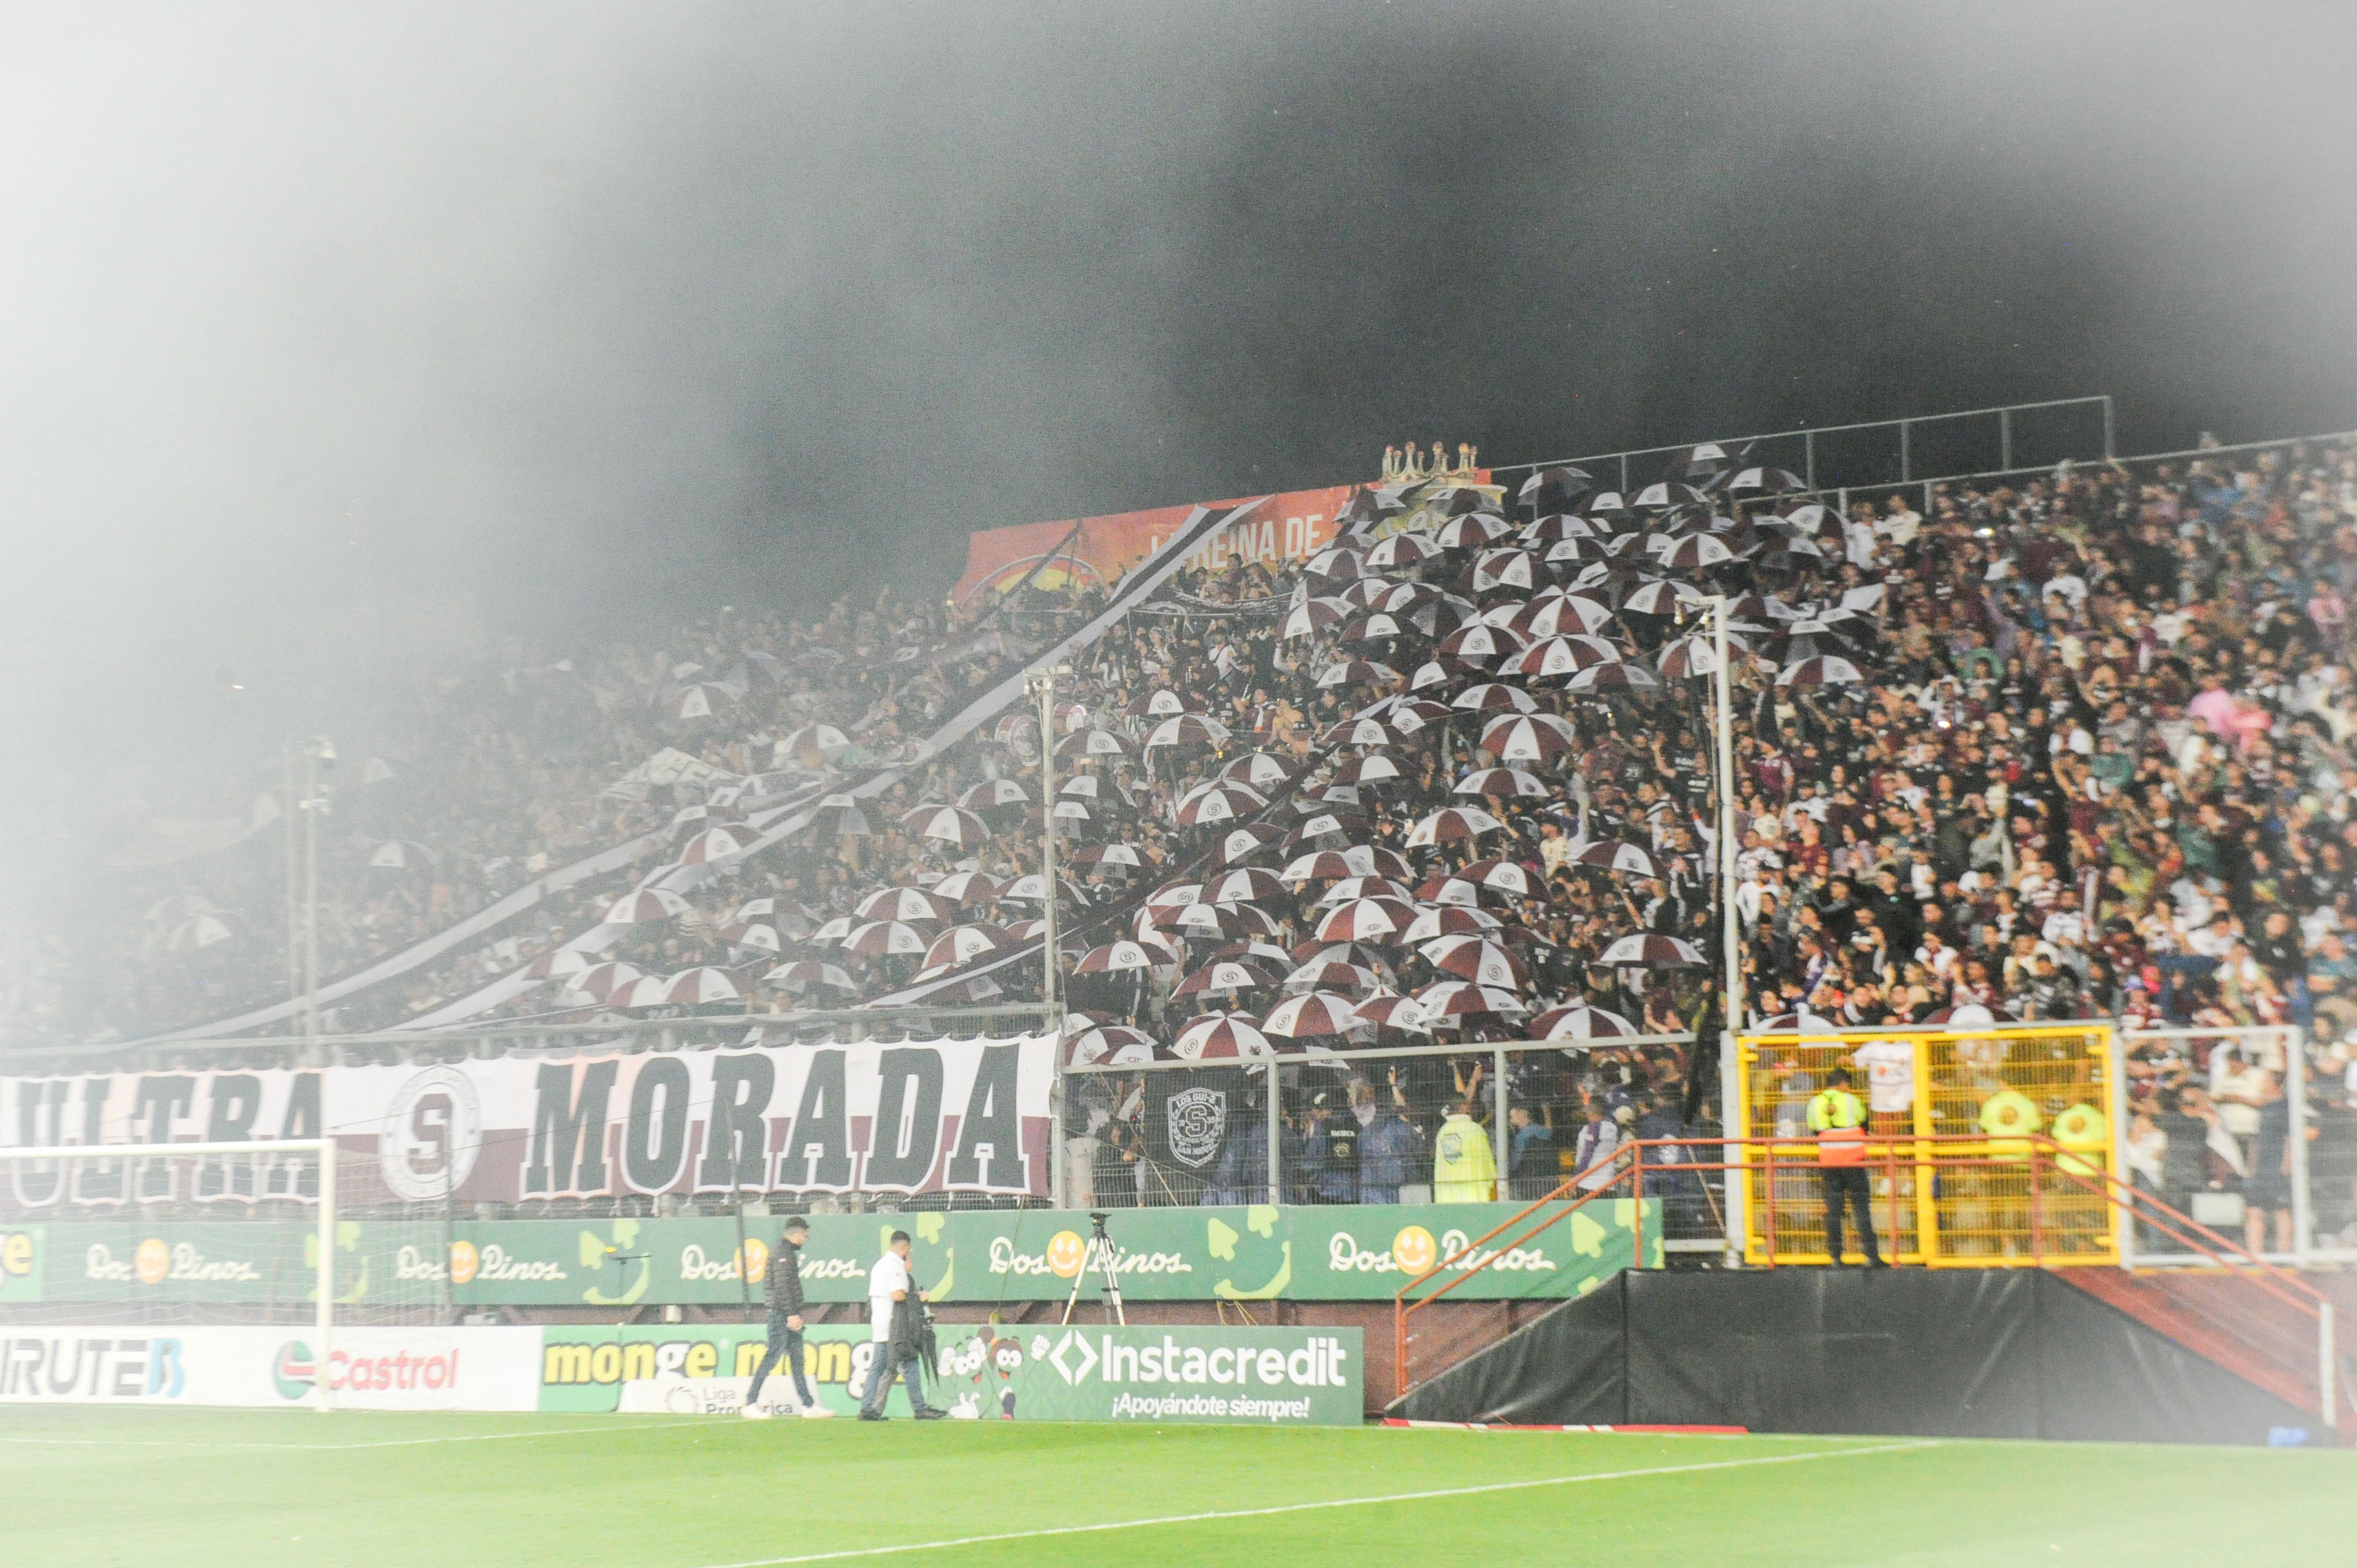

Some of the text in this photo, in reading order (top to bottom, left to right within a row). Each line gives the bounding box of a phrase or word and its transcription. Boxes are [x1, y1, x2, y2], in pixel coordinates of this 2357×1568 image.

[1285, 513, 1324, 560] DE
[1175, 1095, 1191, 1108] LOS
[1185, 1105, 1207, 1137] S
[13, 1042, 1030, 1205] ULTRA S MORADA
[85, 1242, 262, 1282] Dos Pinos
[396, 1244, 568, 1281] Dos Pinos
[680, 1244, 866, 1281] Dos inos
[989, 1236, 1052, 1275] Dos
[1329, 1229, 1557, 1272] Dos Pinos
[328, 1348, 461, 1391] Castrol
[543, 1339, 719, 1386] monge
[1102, 1334, 1347, 1387] Instacredit
[703, 1386, 735, 1403] Liga
[1111, 1391, 1311, 1422] ¡Apoyándote siempre!
